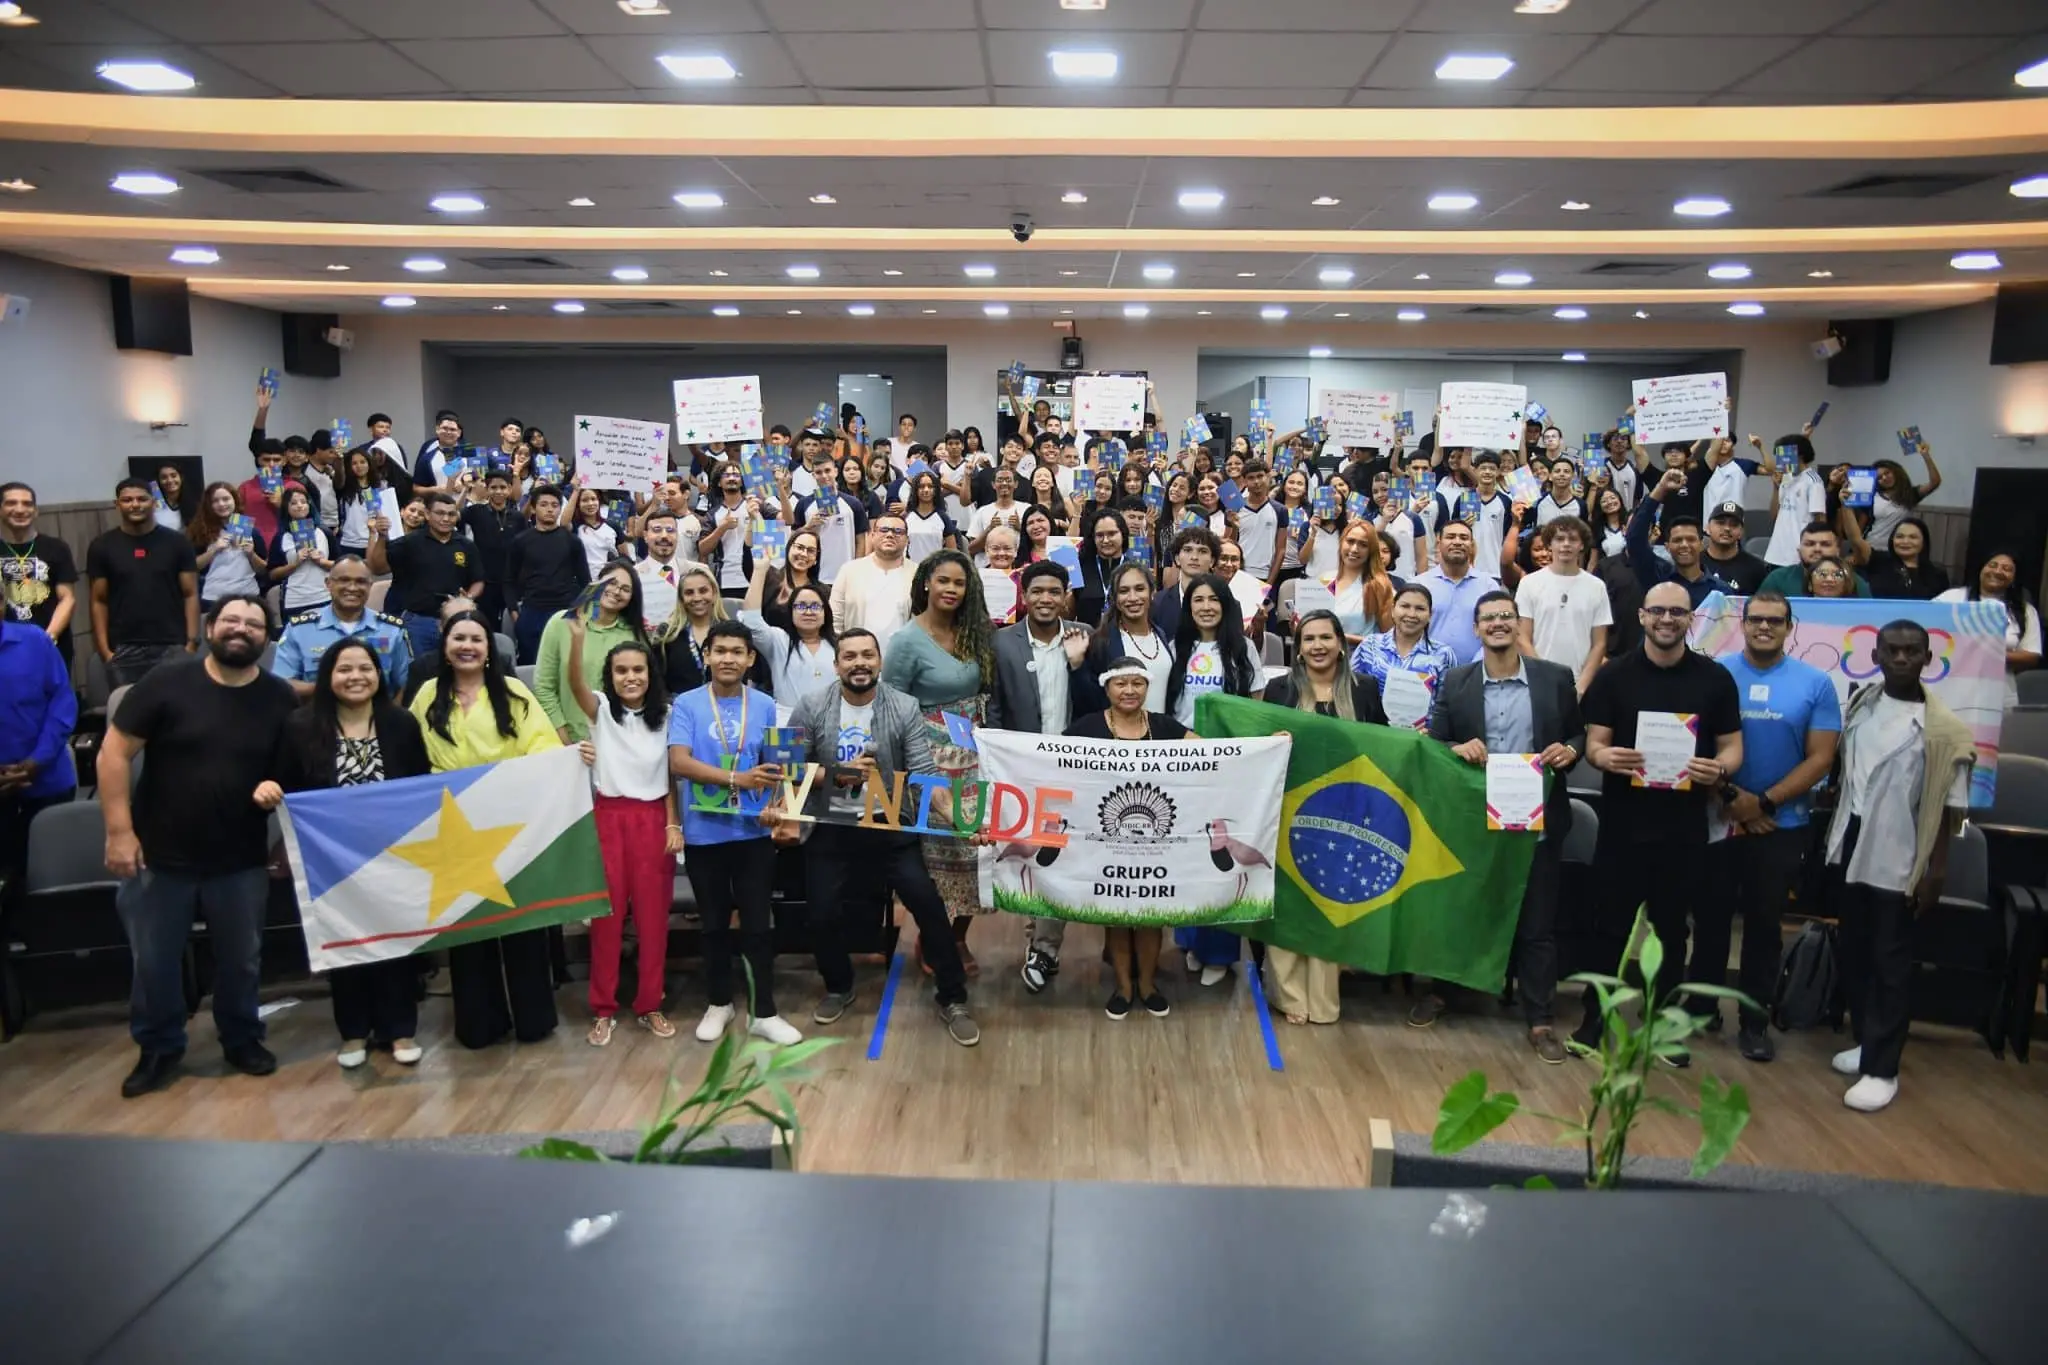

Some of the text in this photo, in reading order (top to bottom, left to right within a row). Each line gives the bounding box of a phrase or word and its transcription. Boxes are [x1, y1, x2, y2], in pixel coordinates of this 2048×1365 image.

[1184, 675, 1224, 686] ONJU
[1037, 742, 1242, 759] ASSOCIAÇÃO ESTADUAL DOS
[1141, 761, 1161, 772] DA
[1167, 760, 1219, 771] CIDADE
[1298, 817, 1404, 860] ORDEM E PROGRESSO
[1102, 865, 1168, 879] GRUPO
[1093, 883, 1175, 898] DIRI-DIRI
